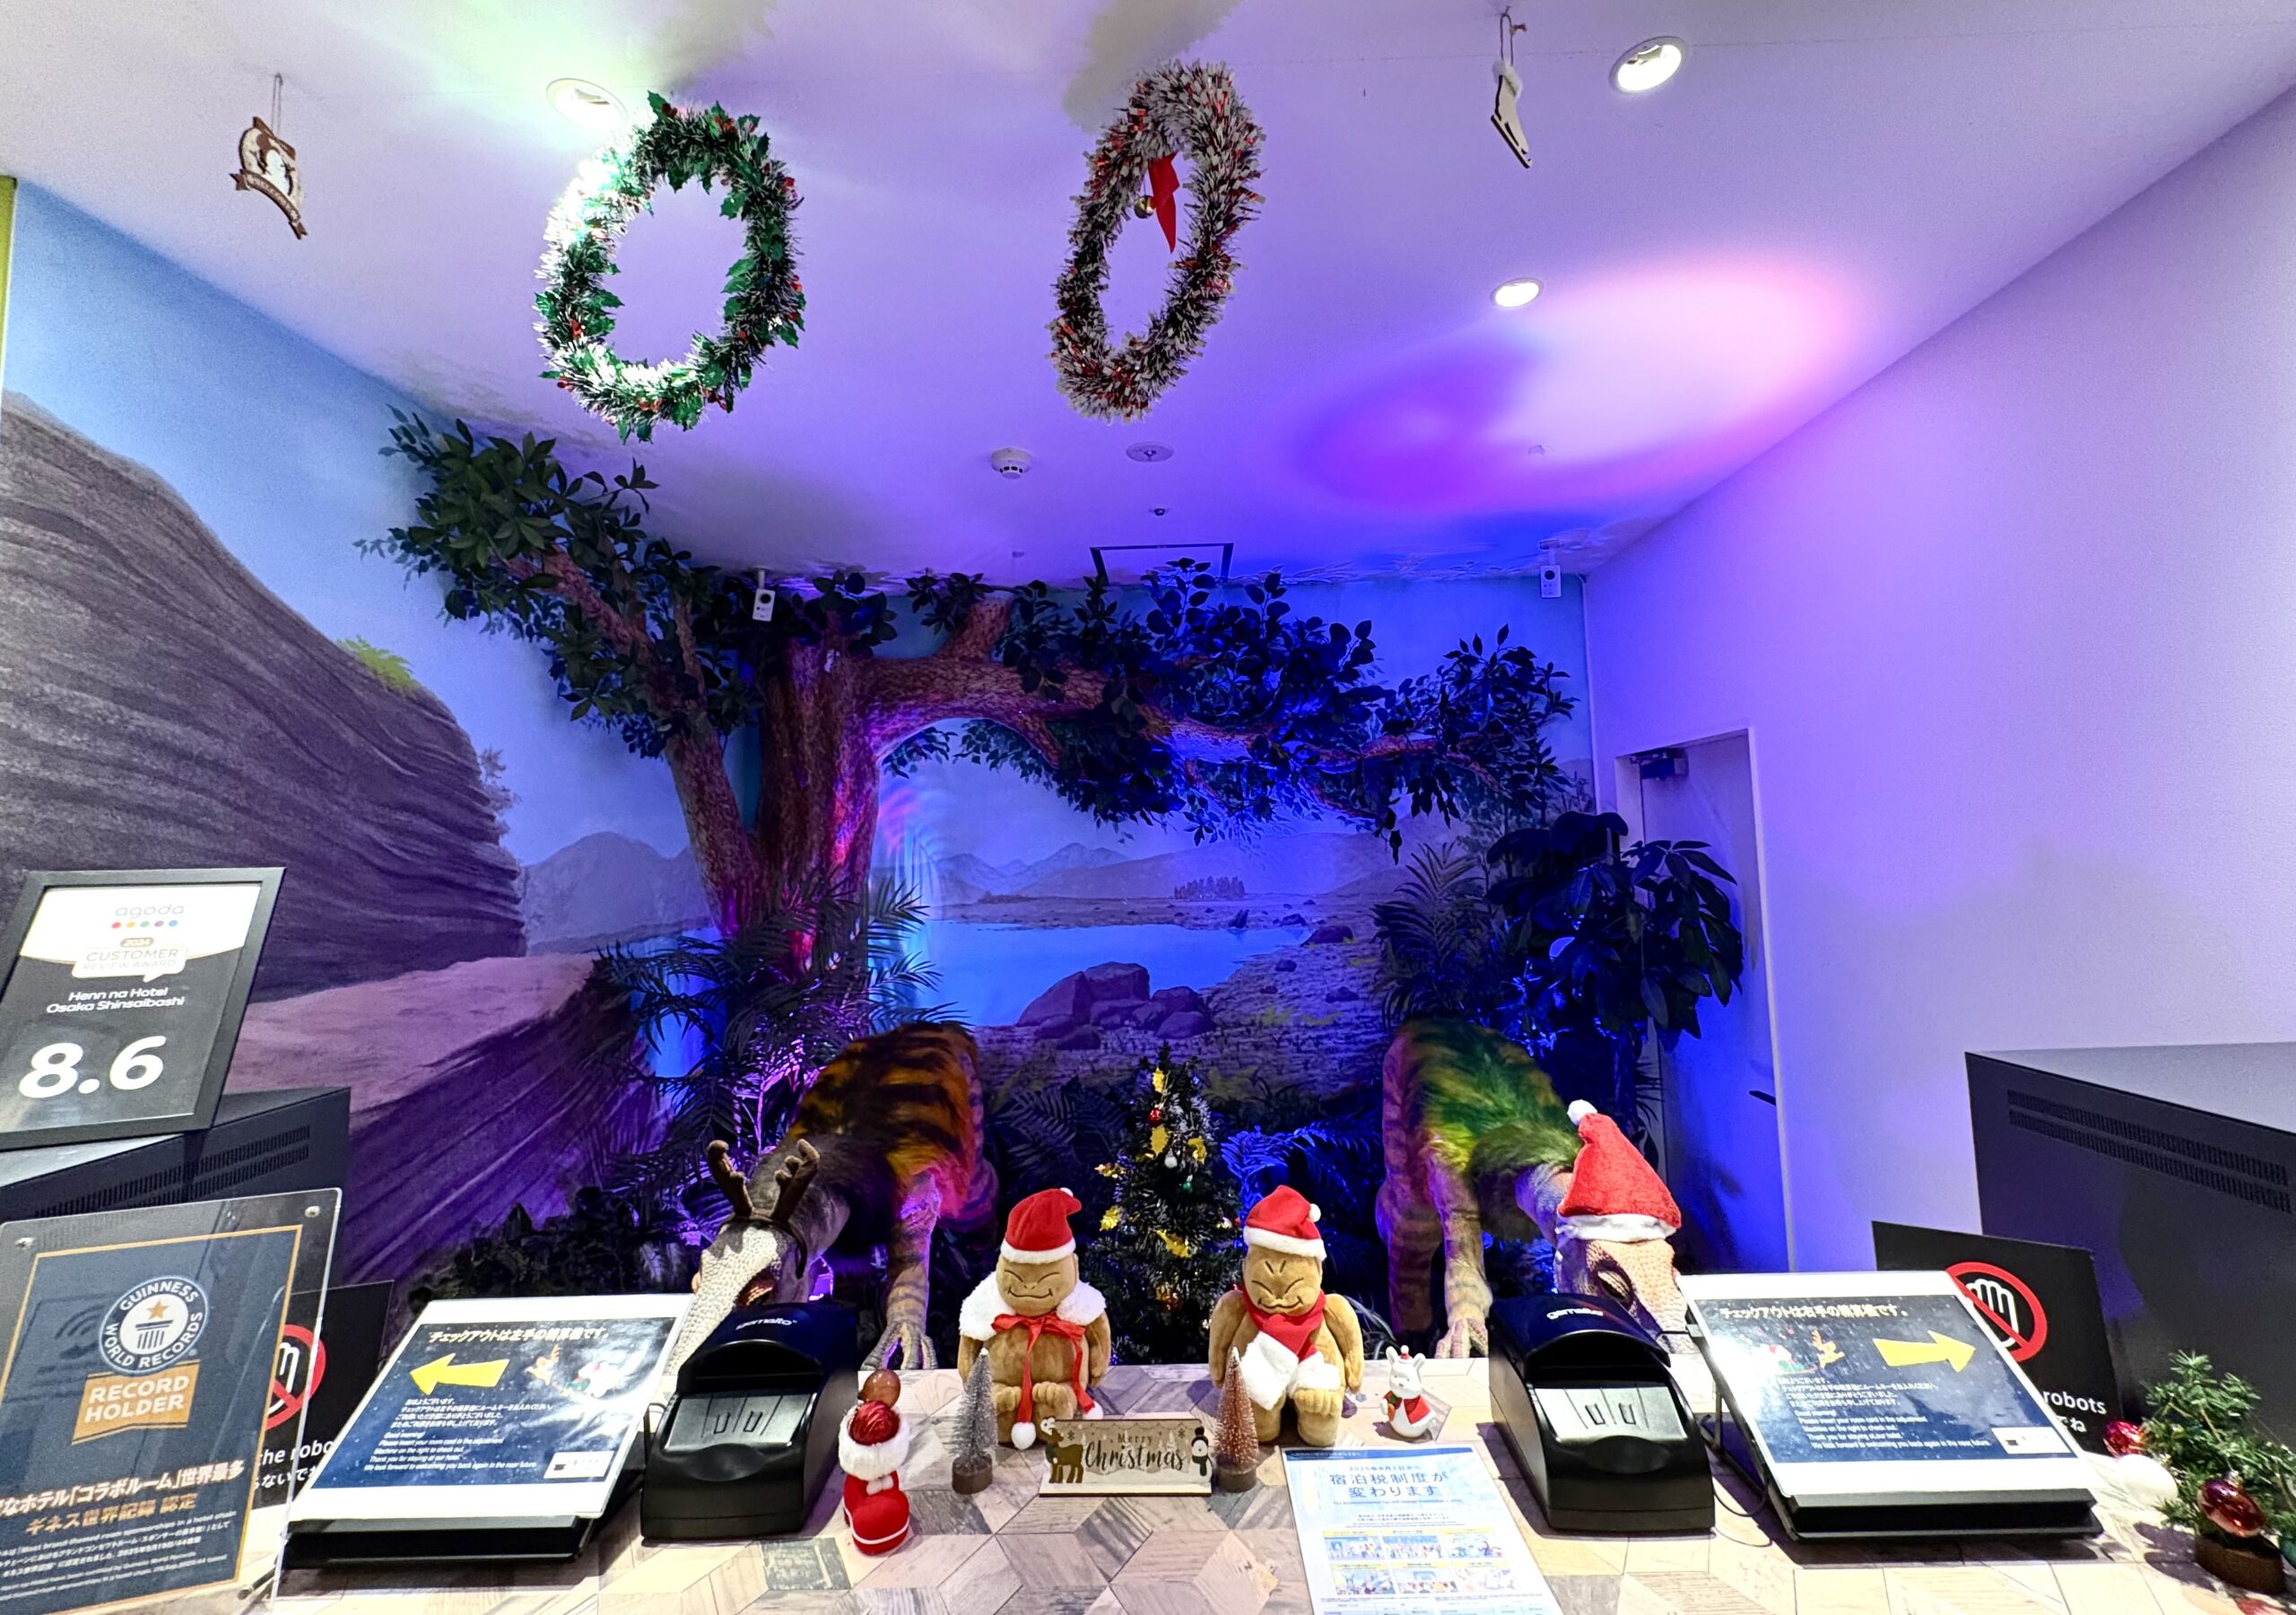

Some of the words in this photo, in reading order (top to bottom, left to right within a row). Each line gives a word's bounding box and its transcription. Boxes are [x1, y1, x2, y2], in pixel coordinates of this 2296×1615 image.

[115, 904, 185, 919] agoda
[83, 962, 127, 970] REVIEW
[134, 959, 177, 968] AWARD
[86, 949, 179, 962] CUSTOMER
[46, 1003, 94, 1013] Osaka
[96, 995, 185, 1011] Shinsaibashi
[68, 991, 106, 1002] Henn
[109, 991, 128, 999] na
[130, 987, 169, 998] Hotel
[18, 1035, 167, 1098] 8.6
[119, 1281, 199, 1311] GUINNESS
[104, 1322, 135, 1368] WORLD
[137, 1311, 204, 1368] RECORDS
[89, 1375, 190, 1404] RECORD
[84, 1394, 185, 1423] HOLDER
[2043, 1391, 2107, 1414] robots
[1118, 1433, 1152, 1444] Merry
[290, 1439, 335, 1461] robo
[1085, 1439, 1185, 1472] Christmas
[1329, 1471, 1448, 1485] 宿泊税制度が
[1348, 1485, 1438, 1498] 変わります
